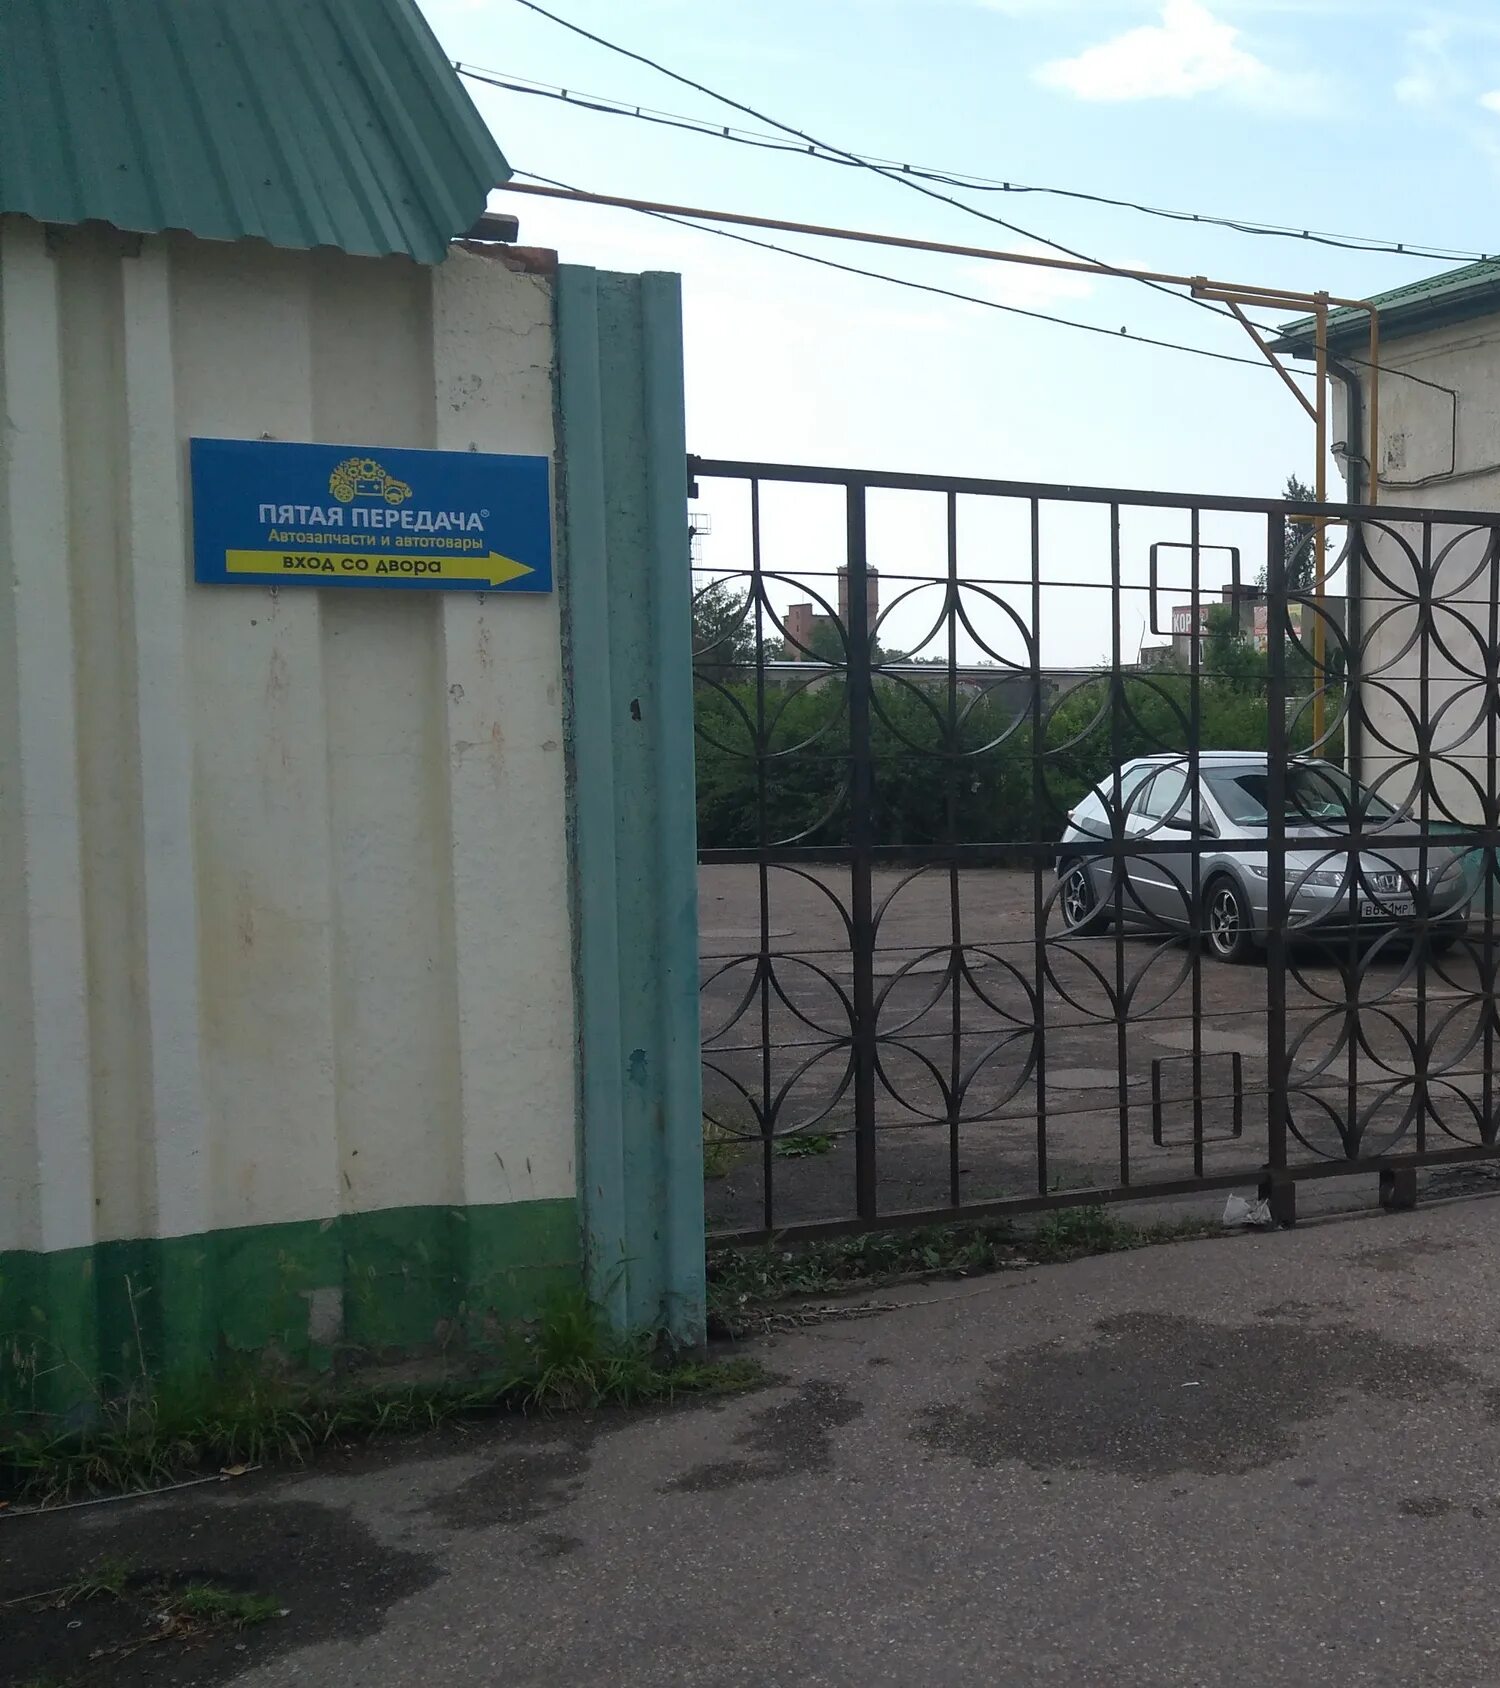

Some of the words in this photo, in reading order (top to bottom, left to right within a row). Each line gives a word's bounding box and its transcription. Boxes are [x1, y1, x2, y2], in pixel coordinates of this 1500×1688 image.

[258, 503, 344, 527] ПЯТАЯ
[268, 528, 376, 546] Автозапчасти
[381, 536, 390, 546] и
[395, 535, 483, 551] автотовары
